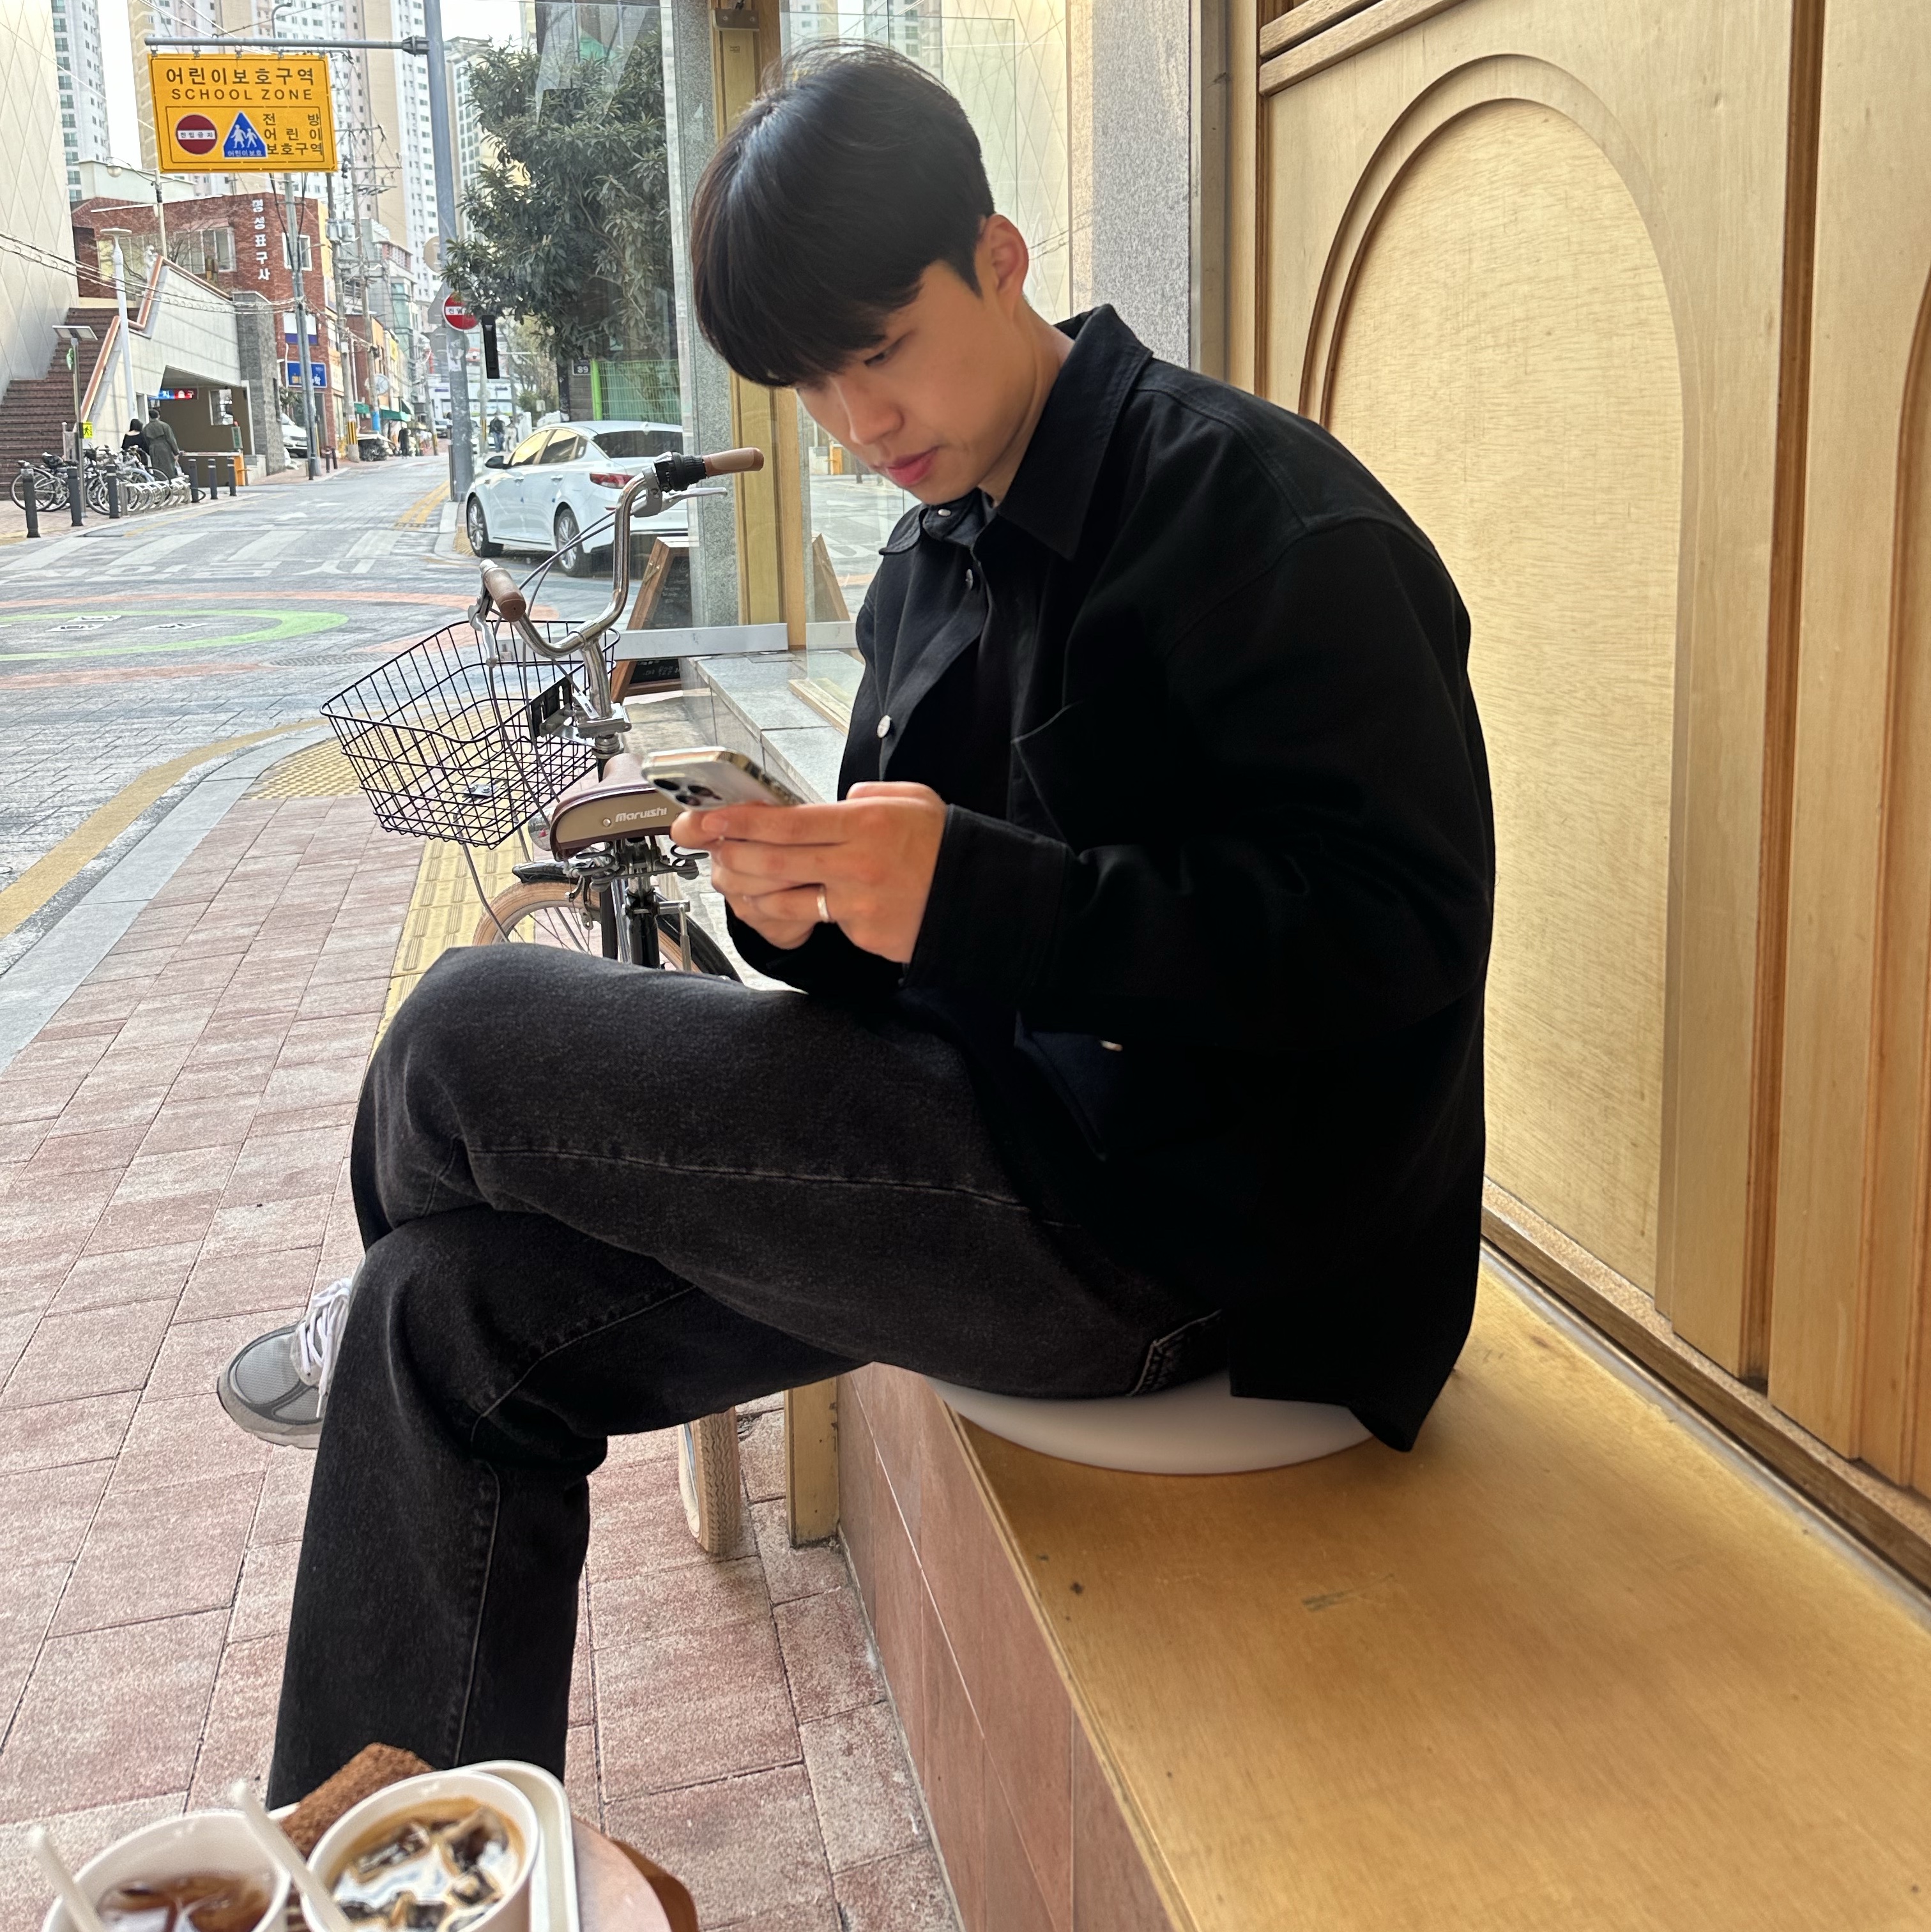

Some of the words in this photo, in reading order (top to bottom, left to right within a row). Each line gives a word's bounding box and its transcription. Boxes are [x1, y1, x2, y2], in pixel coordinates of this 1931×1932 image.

[166, 67, 314, 85] 어린이보호구역
[171, 89, 252, 100] SCHOOL
[261, 89, 312, 100] ZONE
[264, 128, 321, 141] 어린이
[267, 143, 323, 155] 보호구역
[252, 199, 271, 281] 명성표구사
[577, 365, 589, 374] 89
[614, 807, 668, 823] Maruishi
